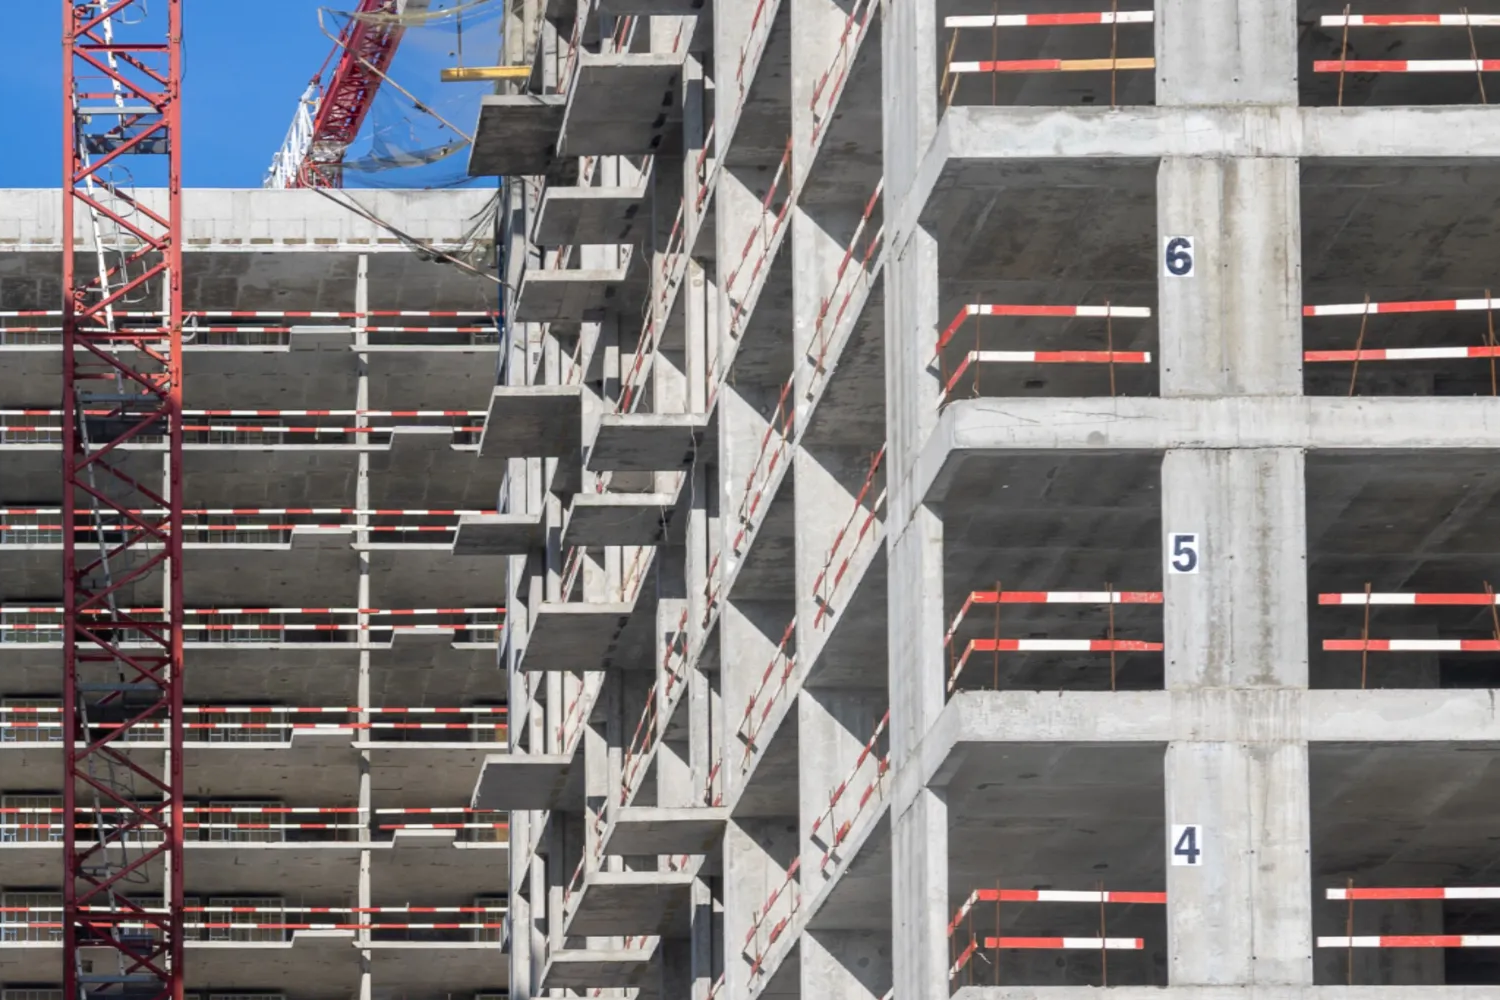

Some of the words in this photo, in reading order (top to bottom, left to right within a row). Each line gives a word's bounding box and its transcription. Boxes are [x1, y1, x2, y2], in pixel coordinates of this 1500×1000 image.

[1165, 237, 1193, 276] 6
[1172, 535, 1197, 572] 5
[1174, 826, 1200, 864] 4
